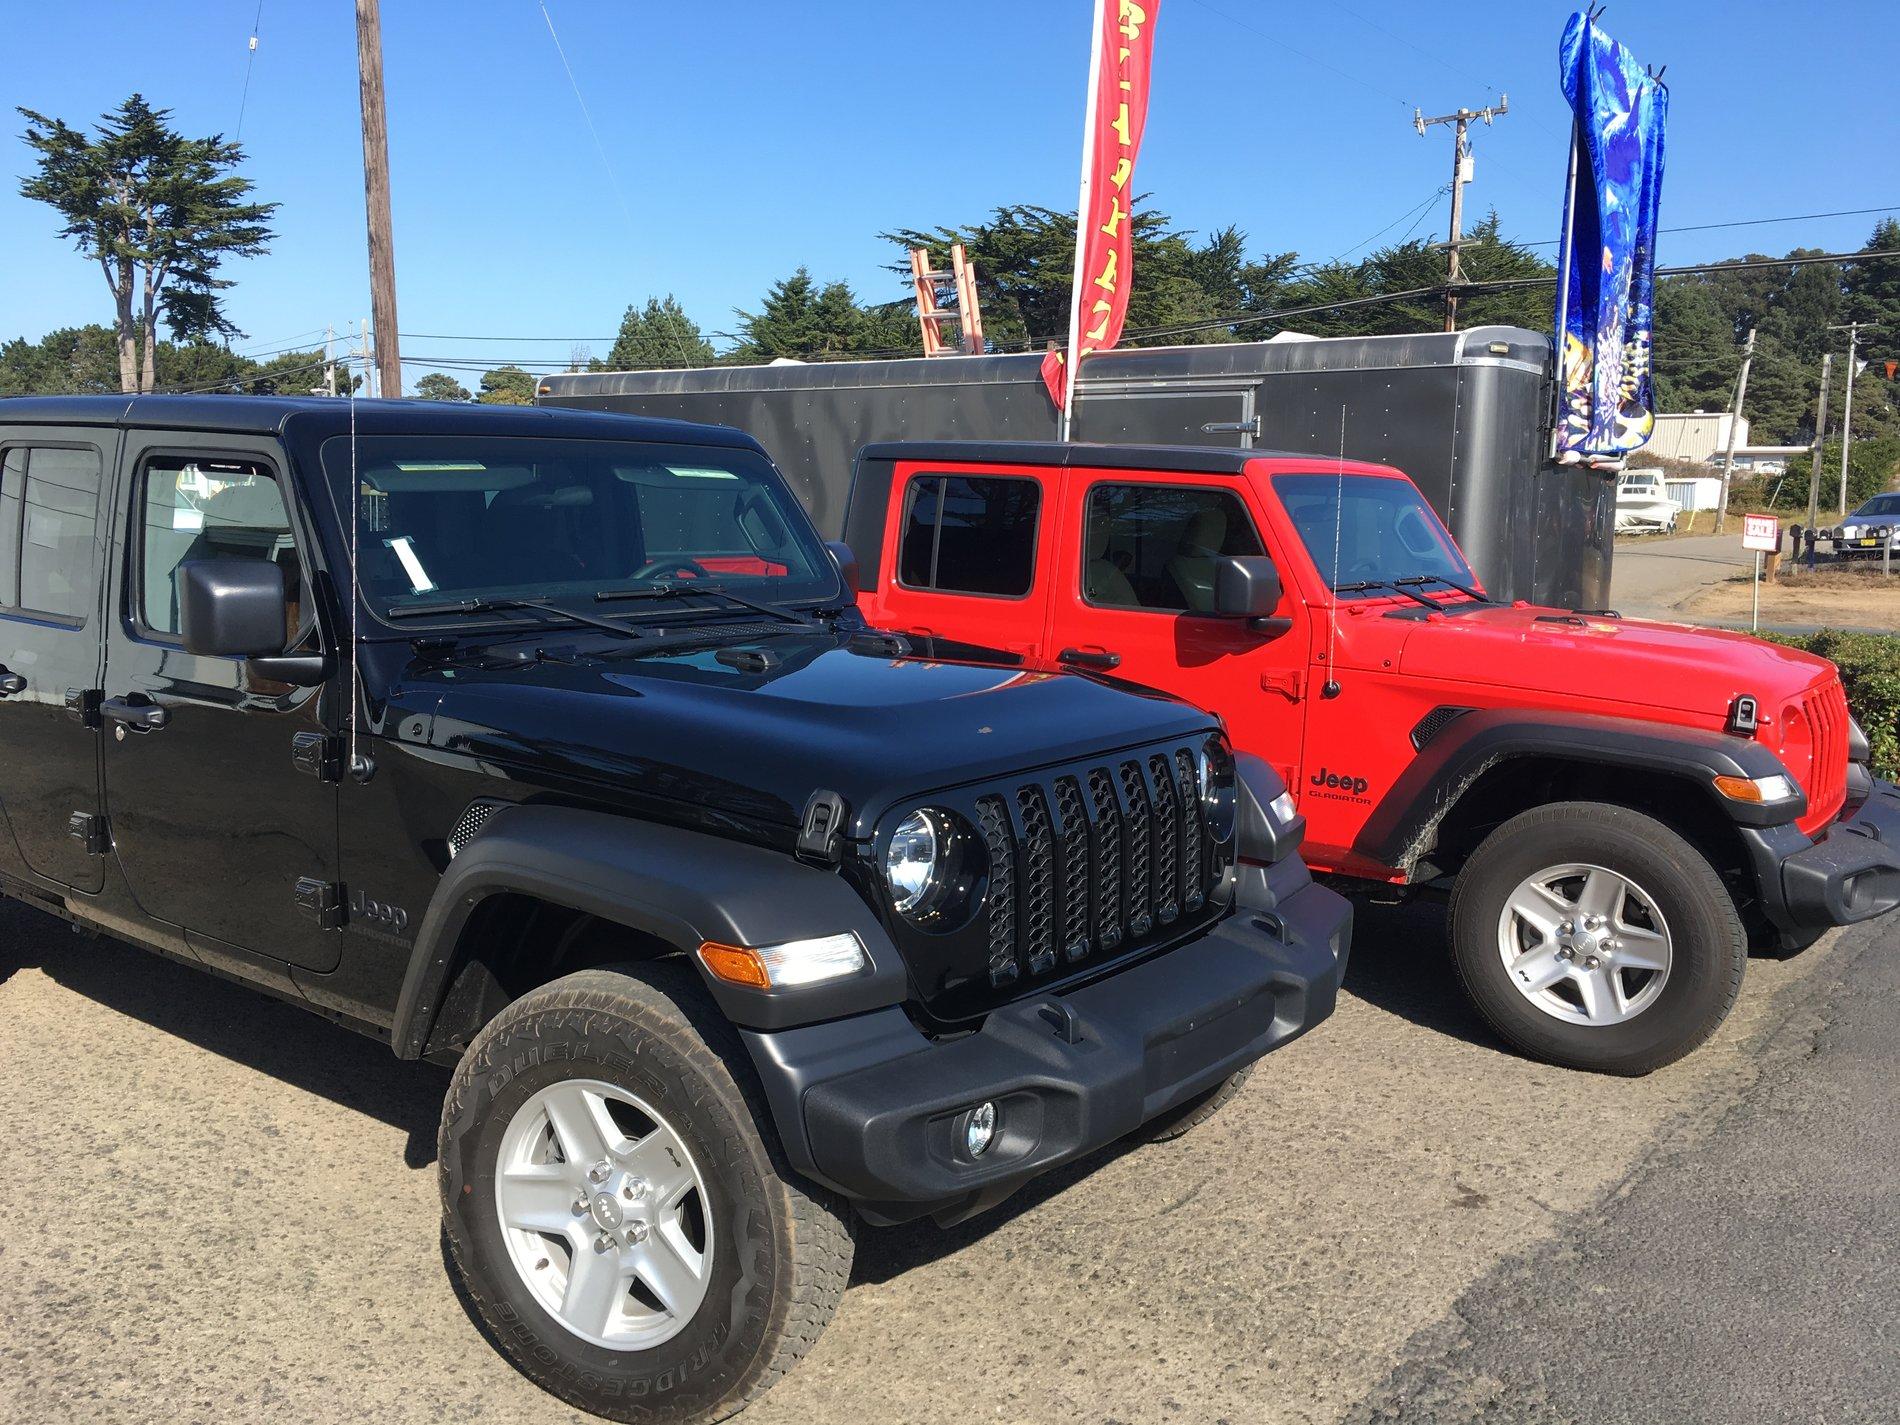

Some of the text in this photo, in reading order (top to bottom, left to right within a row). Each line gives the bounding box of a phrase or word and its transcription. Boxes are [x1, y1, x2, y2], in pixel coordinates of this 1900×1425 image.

[1311, 768, 1368, 795] Jeep
[1309, 790, 1372, 806] GLADIATOR
[351, 889, 408, 934] Jeep
